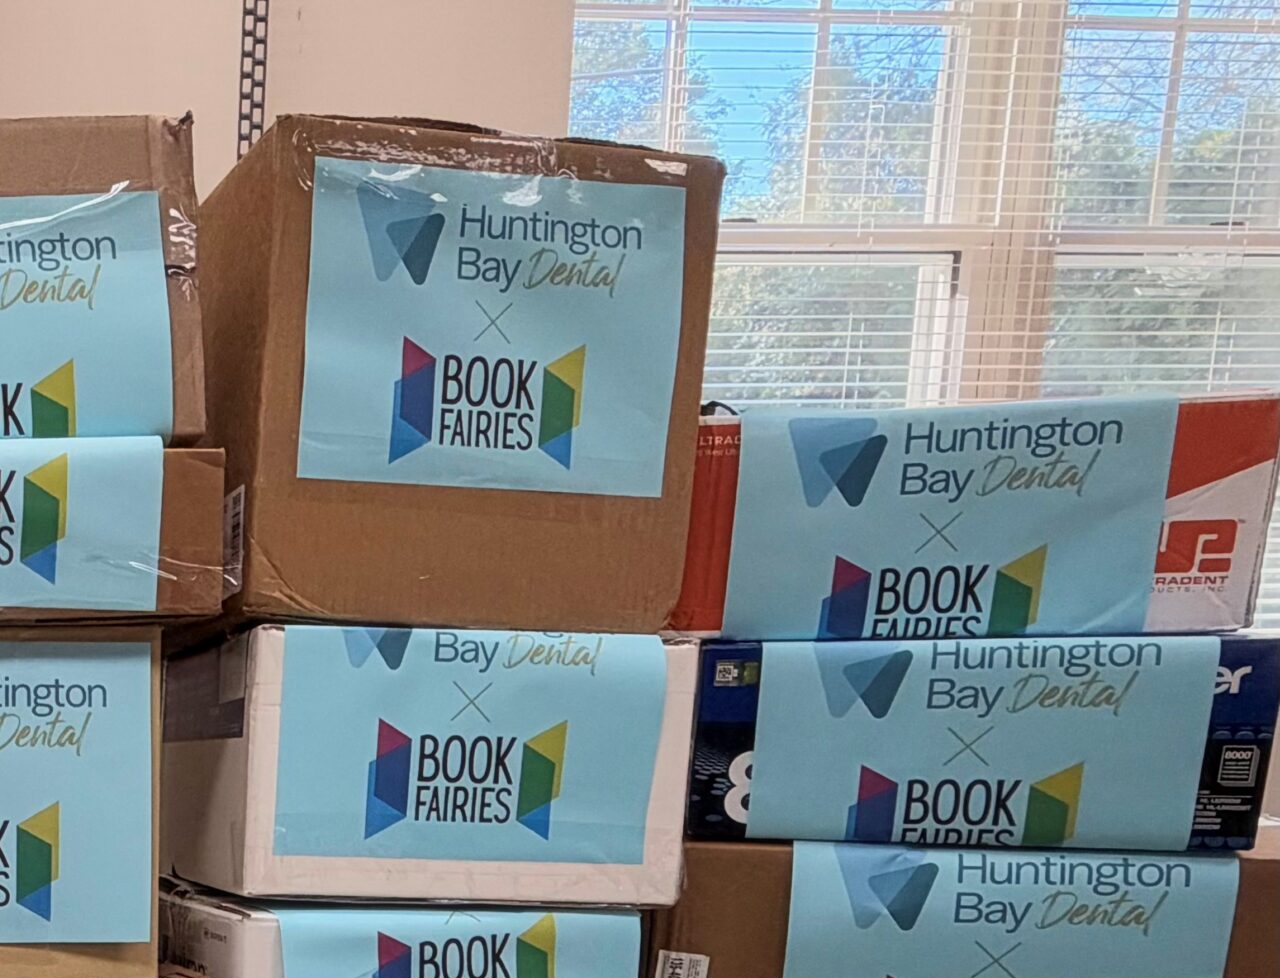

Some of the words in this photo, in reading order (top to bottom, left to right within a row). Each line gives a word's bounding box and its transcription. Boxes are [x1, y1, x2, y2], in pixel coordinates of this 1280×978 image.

[460, 205, 641, 255] Huntington
[458, 247, 522, 293] Bay
[522, 248, 625, 298] Dental
[442, 355, 537, 410] BOOK
[439, 408, 533, 450] FAIRIES
[905, 417, 1123, 458] Huntington
[900, 463, 974, 503] Bay
[975, 449, 1101, 497] Dental
[874, 564, 990, 615] BOOK
[1153, 576, 1229, 585] RADENT
[434, 632, 499, 673] Bay
[502, 635, 604, 677] Dental
[931, 641, 1162, 678] Huntington
[927, 678, 1004, 718] Bay
[1006, 670, 1139, 716] Dental
[417, 735, 517, 785] BOOK
[415, 786, 512, 823] FAIRIES
[902, 778, 1022, 826] BOOK
[956, 854, 1191, 895] Huntington
[954, 893, 1033, 933] Bay
[1035, 891, 1169, 937] Dental
